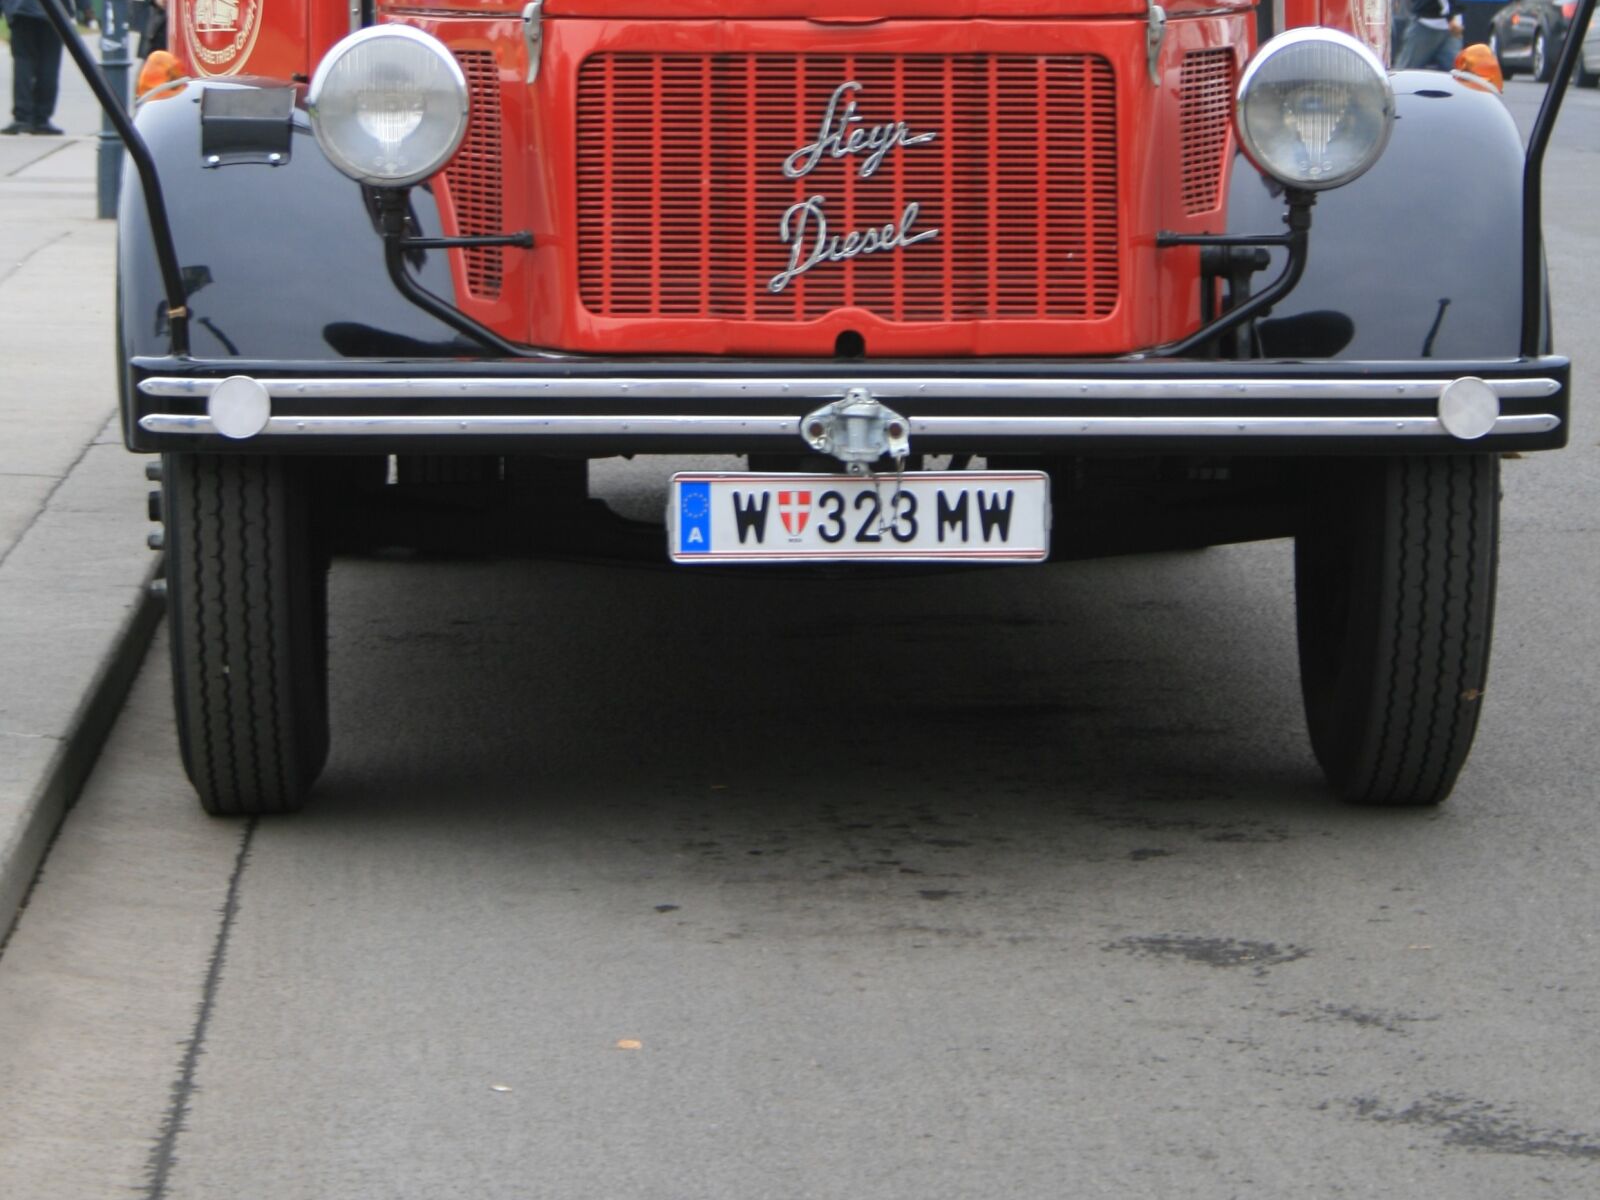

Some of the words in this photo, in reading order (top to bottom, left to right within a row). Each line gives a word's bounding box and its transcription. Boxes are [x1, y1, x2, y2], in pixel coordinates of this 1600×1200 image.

[783, 80, 936, 178] Steyr
[767, 194, 939, 293] Diesel
[687, 526, 703, 543] A
[732, 490, 770, 544] W
[817, 489, 919, 543] 323
[936, 489, 1015, 543] MW
